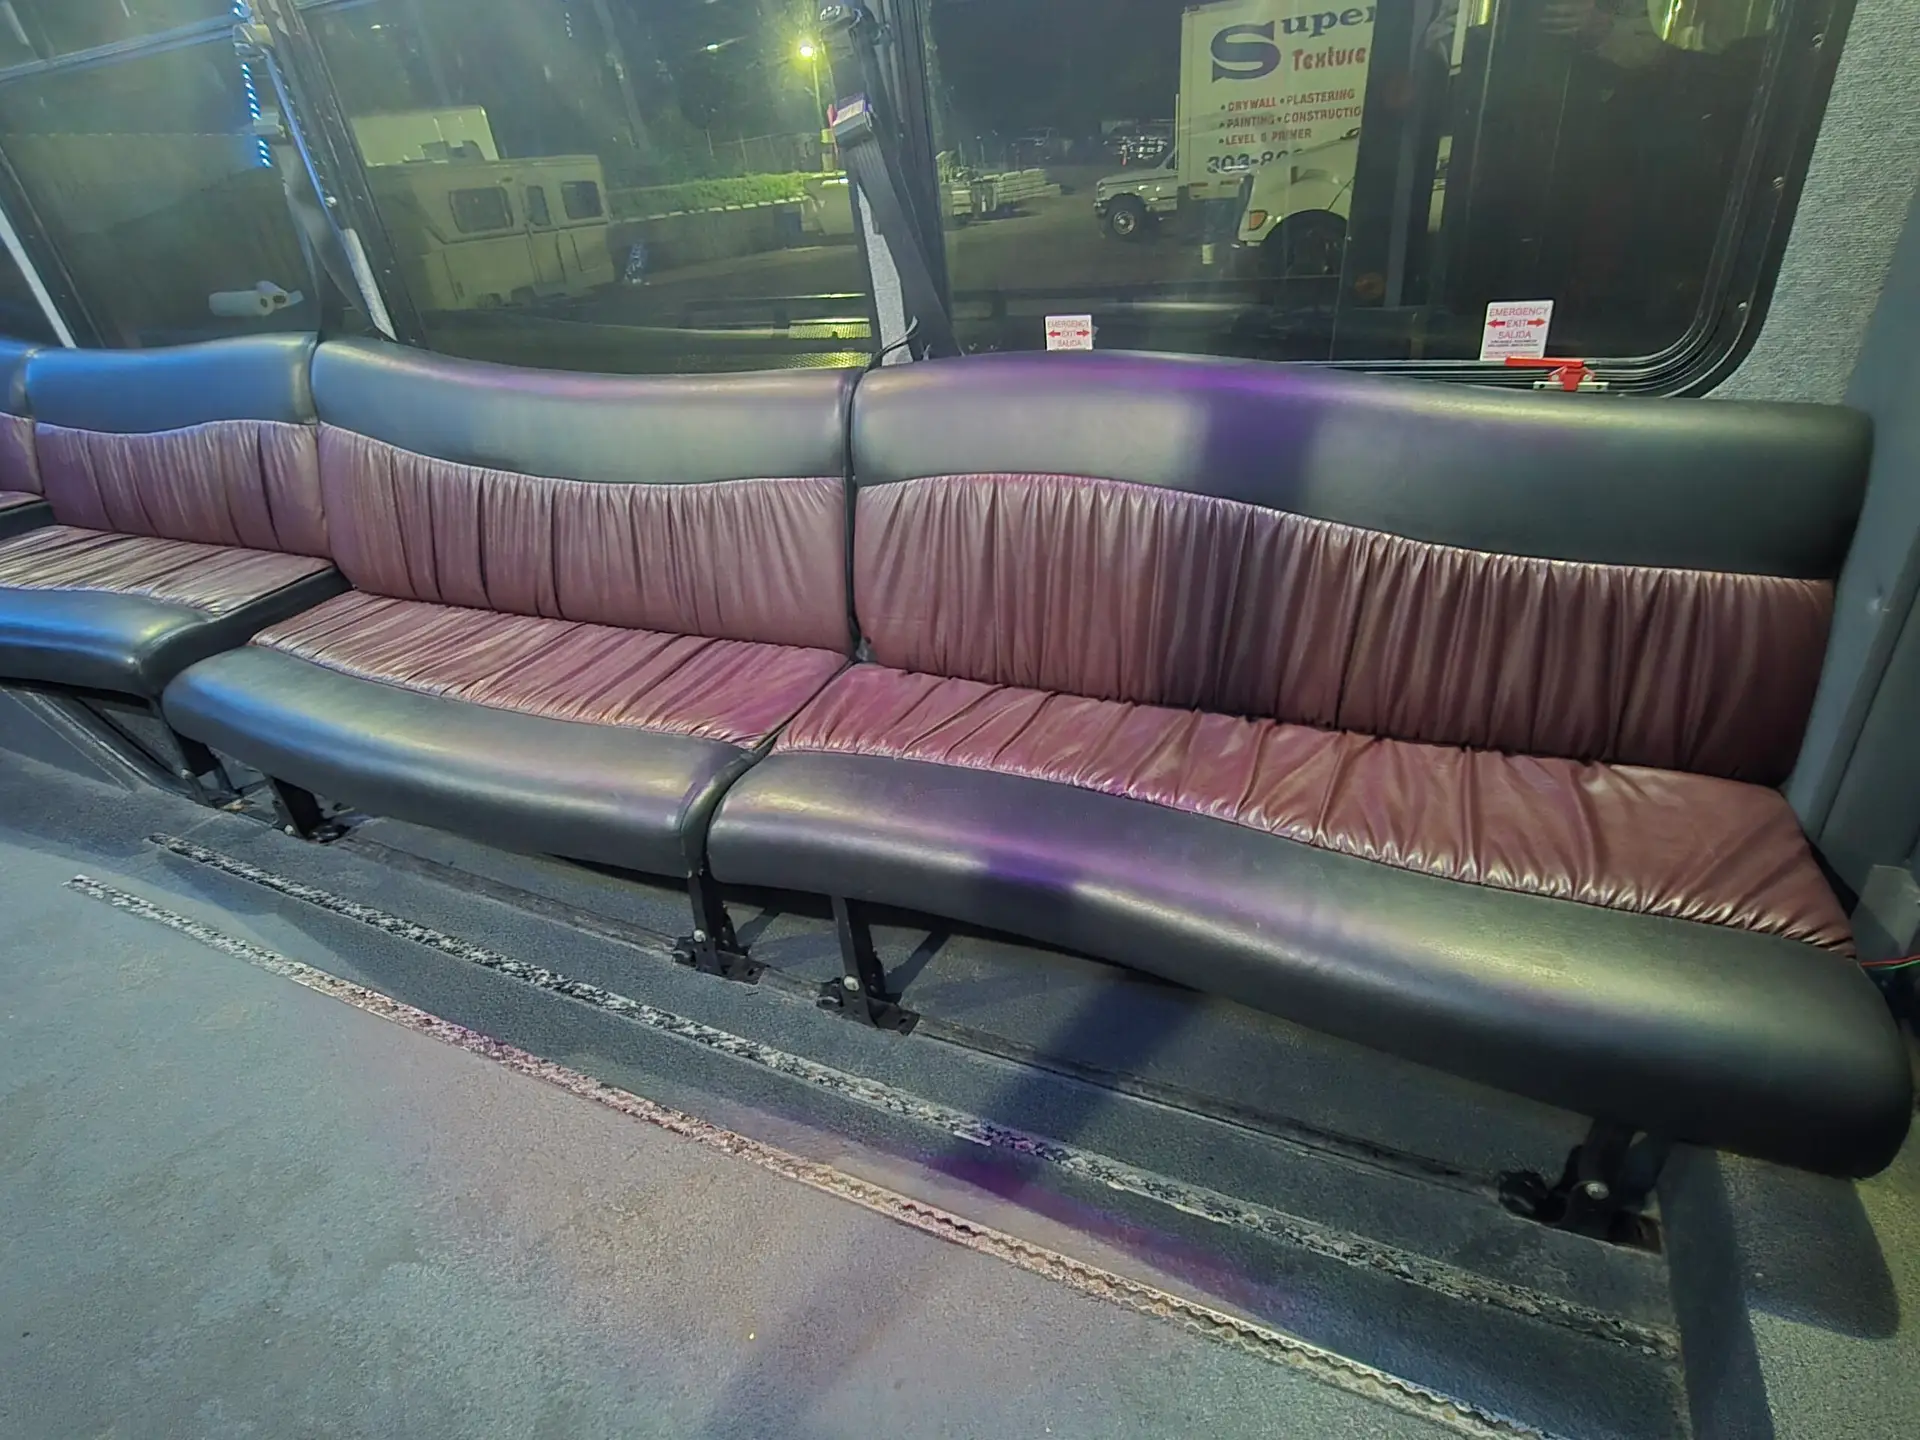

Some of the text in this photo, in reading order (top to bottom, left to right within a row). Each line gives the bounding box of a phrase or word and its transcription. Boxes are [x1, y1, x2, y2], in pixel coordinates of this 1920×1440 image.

[1292, 46, 1366, 71] Texture
[1228, 88, 1355, 112] DRYWALL PLASTERING
[1227, 106, 1361, 129] PAINTING CONSTRUCTIO
[1225, 134, 1256, 146] LEVEL
[1271, 128, 1312, 143] PRIMER
[1489, 307, 1548, 317] EMERGENCY
[1506, 319, 1527, 328] EXIT
[1498, 330, 1532, 339] SALIDA
